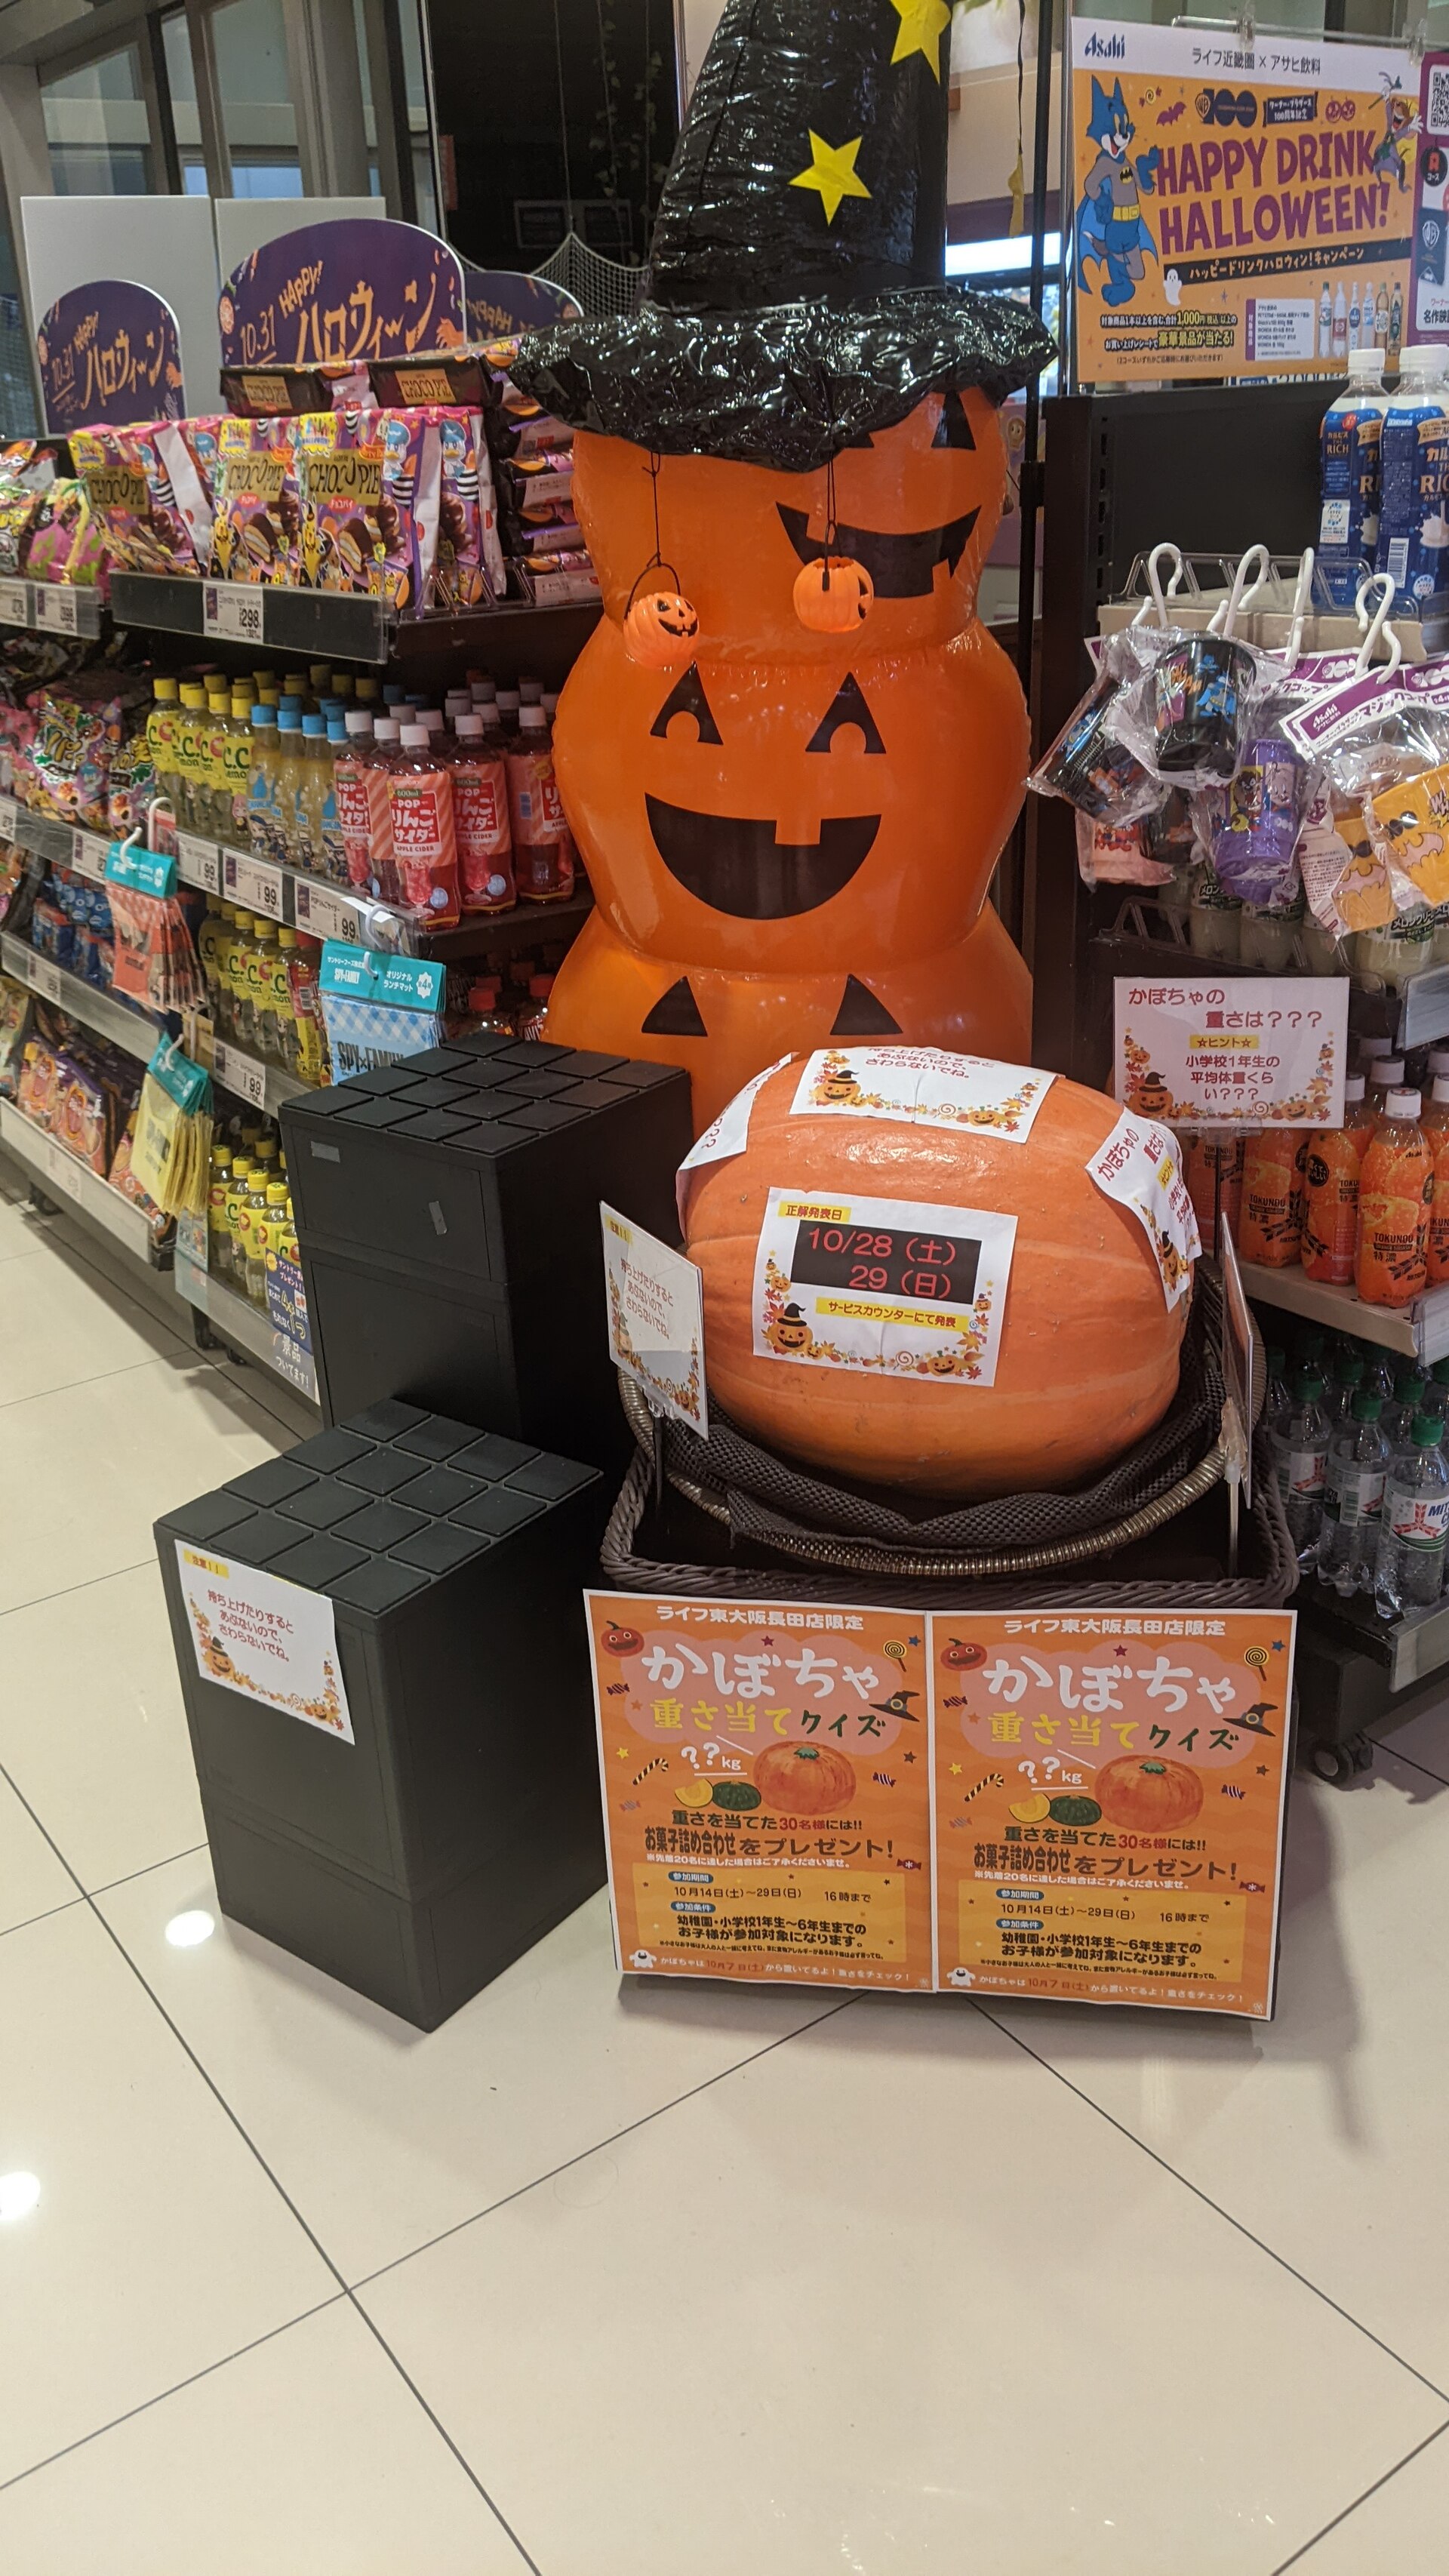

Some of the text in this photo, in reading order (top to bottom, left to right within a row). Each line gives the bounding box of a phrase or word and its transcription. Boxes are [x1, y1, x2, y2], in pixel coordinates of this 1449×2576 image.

[1084, 32, 1124, 60] Asahi
[1192, 48, 1255, 70] ライフ近畿圏
[1271, 55, 1321, 75] アサヒ飲料
[1157, 130, 1377, 196] HAPPY DRINK
[1159, 183, 1390, 254] HALLOWEEN!
[278, 260, 323, 319] HAPPY!
[1424, 309, 1449, 324] 名作映
[240, 304, 275, 364] 10.31
[1327, 444, 1349, 454] RICH
[309, 458, 355, 493] CHOCO
[1312, 703, 1338, 728] Asahi
[457, 788, 480, 796] POP
[398, 799, 420, 808] POP
[392, 810, 436, 827] りんご
[394, 829, 436, 844] サイダー
[264, 886, 277, 905] 99
[342, 918, 356, 938] 99
[386, 971, 412, 981] オリジナル
[383, 980, 414, 993] ランチマット
[1129, 987, 1225, 1005] かぼちゃの
[1205, 1011, 1322, 1029] 重さは???
[866, 1058, 970, 1079] さわらないでね。
[877, 1052, 967, 1070] あぶないので、
[1186, 1055, 1280, 1068] 小学校1年生の
[249, 1077, 261, 1095] 99
[1191, 1071, 1274, 1085] 平均体重くら
[1204, 1087, 1259, 1100] い???
[1097, 1128, 1140, 1181] かぼちゃの
[1249, 1194, 1285, 1207] TOKUNOU
[786, 1205, 842, 1220] 正解発表日
[1374, 1233, 1414, 1243] TOKUNOU
[829, 1301, 956, 1328] サービスカウンターにて発表
[208, 1590, 294, 1634] 持ち上げたりすると
[657, 1605, 864, 1631] ライフ東大阪長田店限定
[220, 1610, 283, 1643] あぶないので、
[1004, 1619, 1226, 1636] ライフ東大阪長田店限定
[218, 1624, 290, 1662] さわらないでね。
[642, 1643, 878, 1699] かぼちゃ
[983, 1656, 1235, 1714] かぼちゃ
[650, 1697, 886, 1738] 重さ当てクイズ
[988, 1711, 1239, 1752] 重さ当てクイズ
[672, 1811, 862, 1831] 重さを当てた30名様には!!
[1004, 1827, 1206, 1851] 重さを当てた30名様には!!
[673, 1873, 709, 1882] 参加期間
[825, 1891, 872, 1903] 16時まで
[1001, 1891, 1039, 1900] 参加期間
[676, 1903, 711, 1913] 参加条件
[1160, 1911, 1210, 1923] 16時まで
[1001, 1920, 1039, 1930] 参加条件
[678, 1928, 863, 1948] お子様が参加対象になります。
[1001, 1945, 1197, 1968] お子様が参加対象になります。
